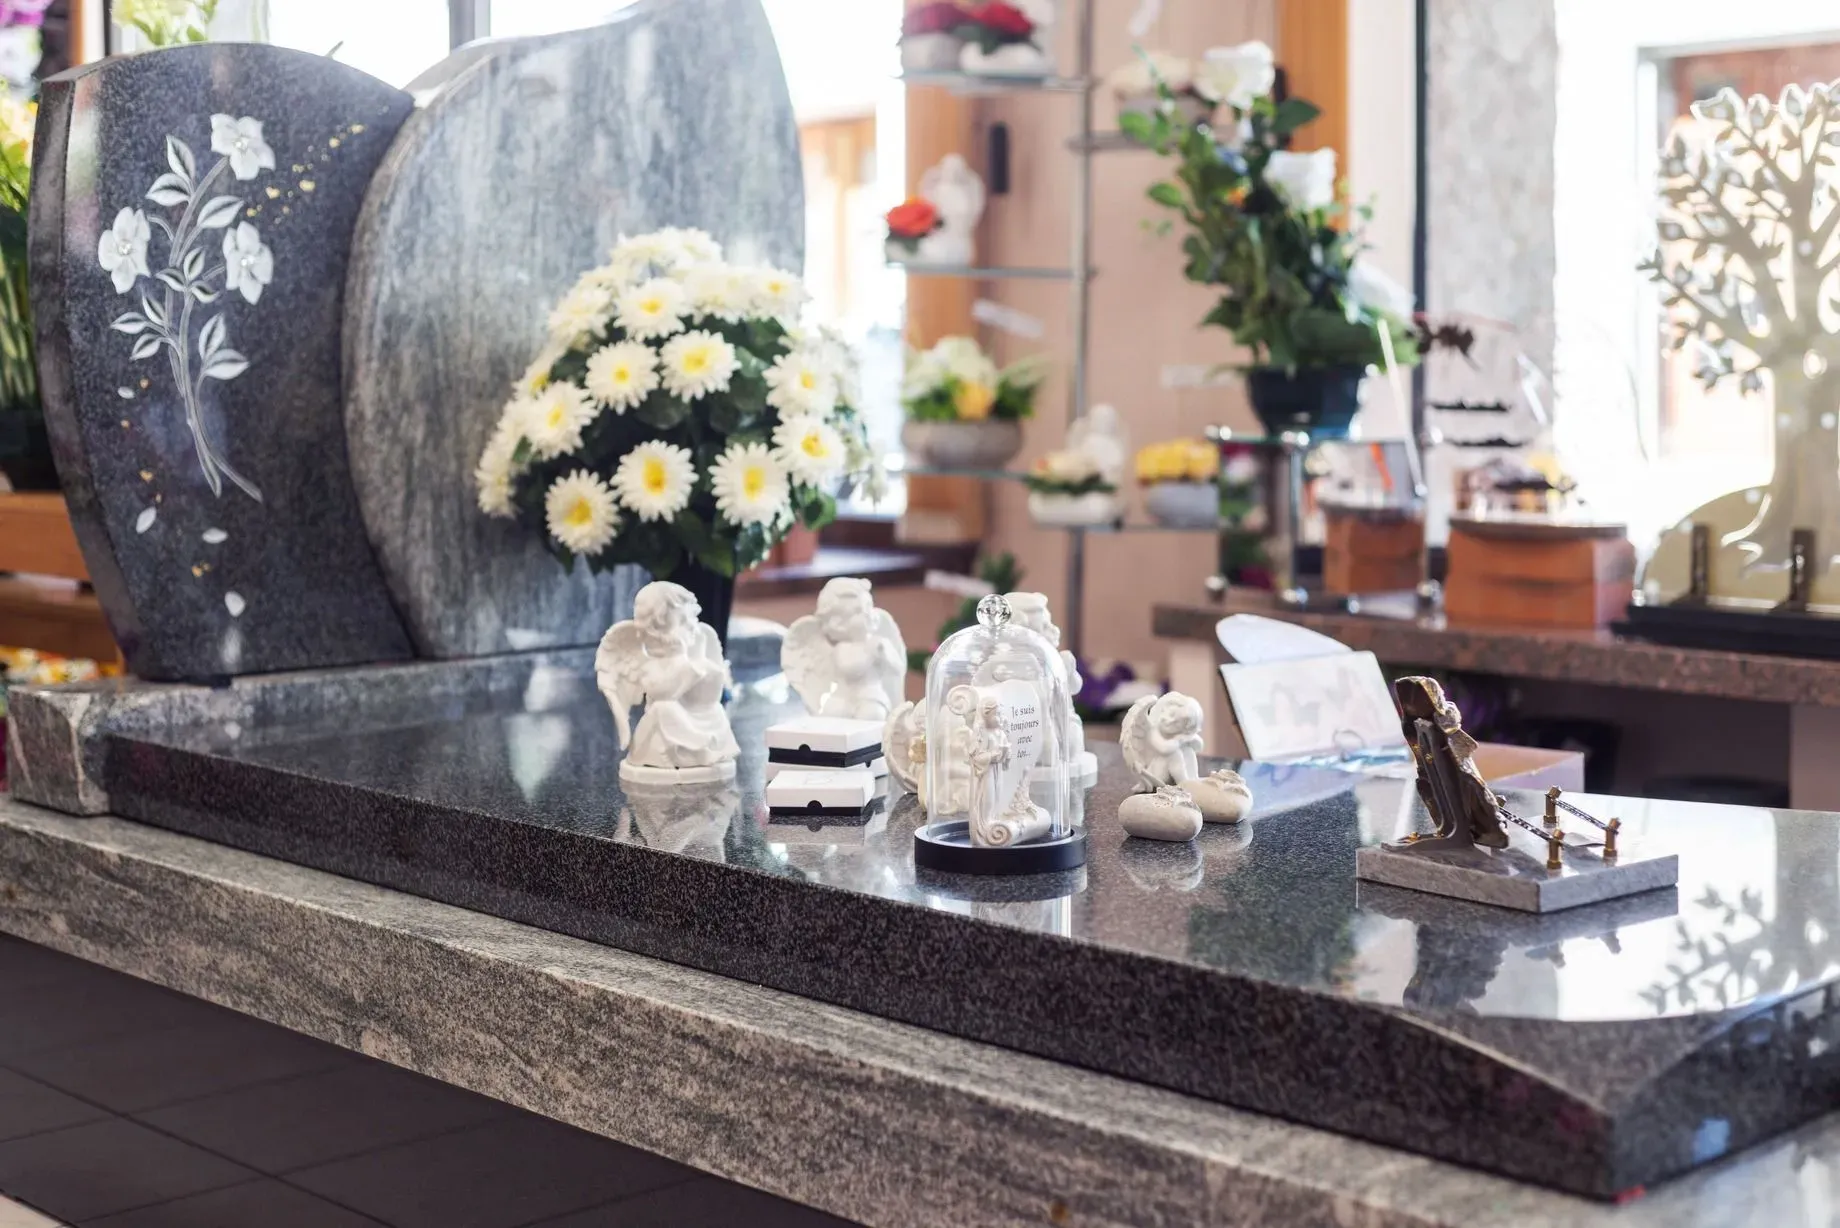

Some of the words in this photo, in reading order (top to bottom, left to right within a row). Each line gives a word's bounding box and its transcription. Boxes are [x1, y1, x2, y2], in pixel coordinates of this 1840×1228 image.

[1011, 706, 1019, 718] Je
[1020, 704, 1035, 716] suis
[1010, 719, 1040, 732] toujours
[1017, 735, 1033, 745] avec
